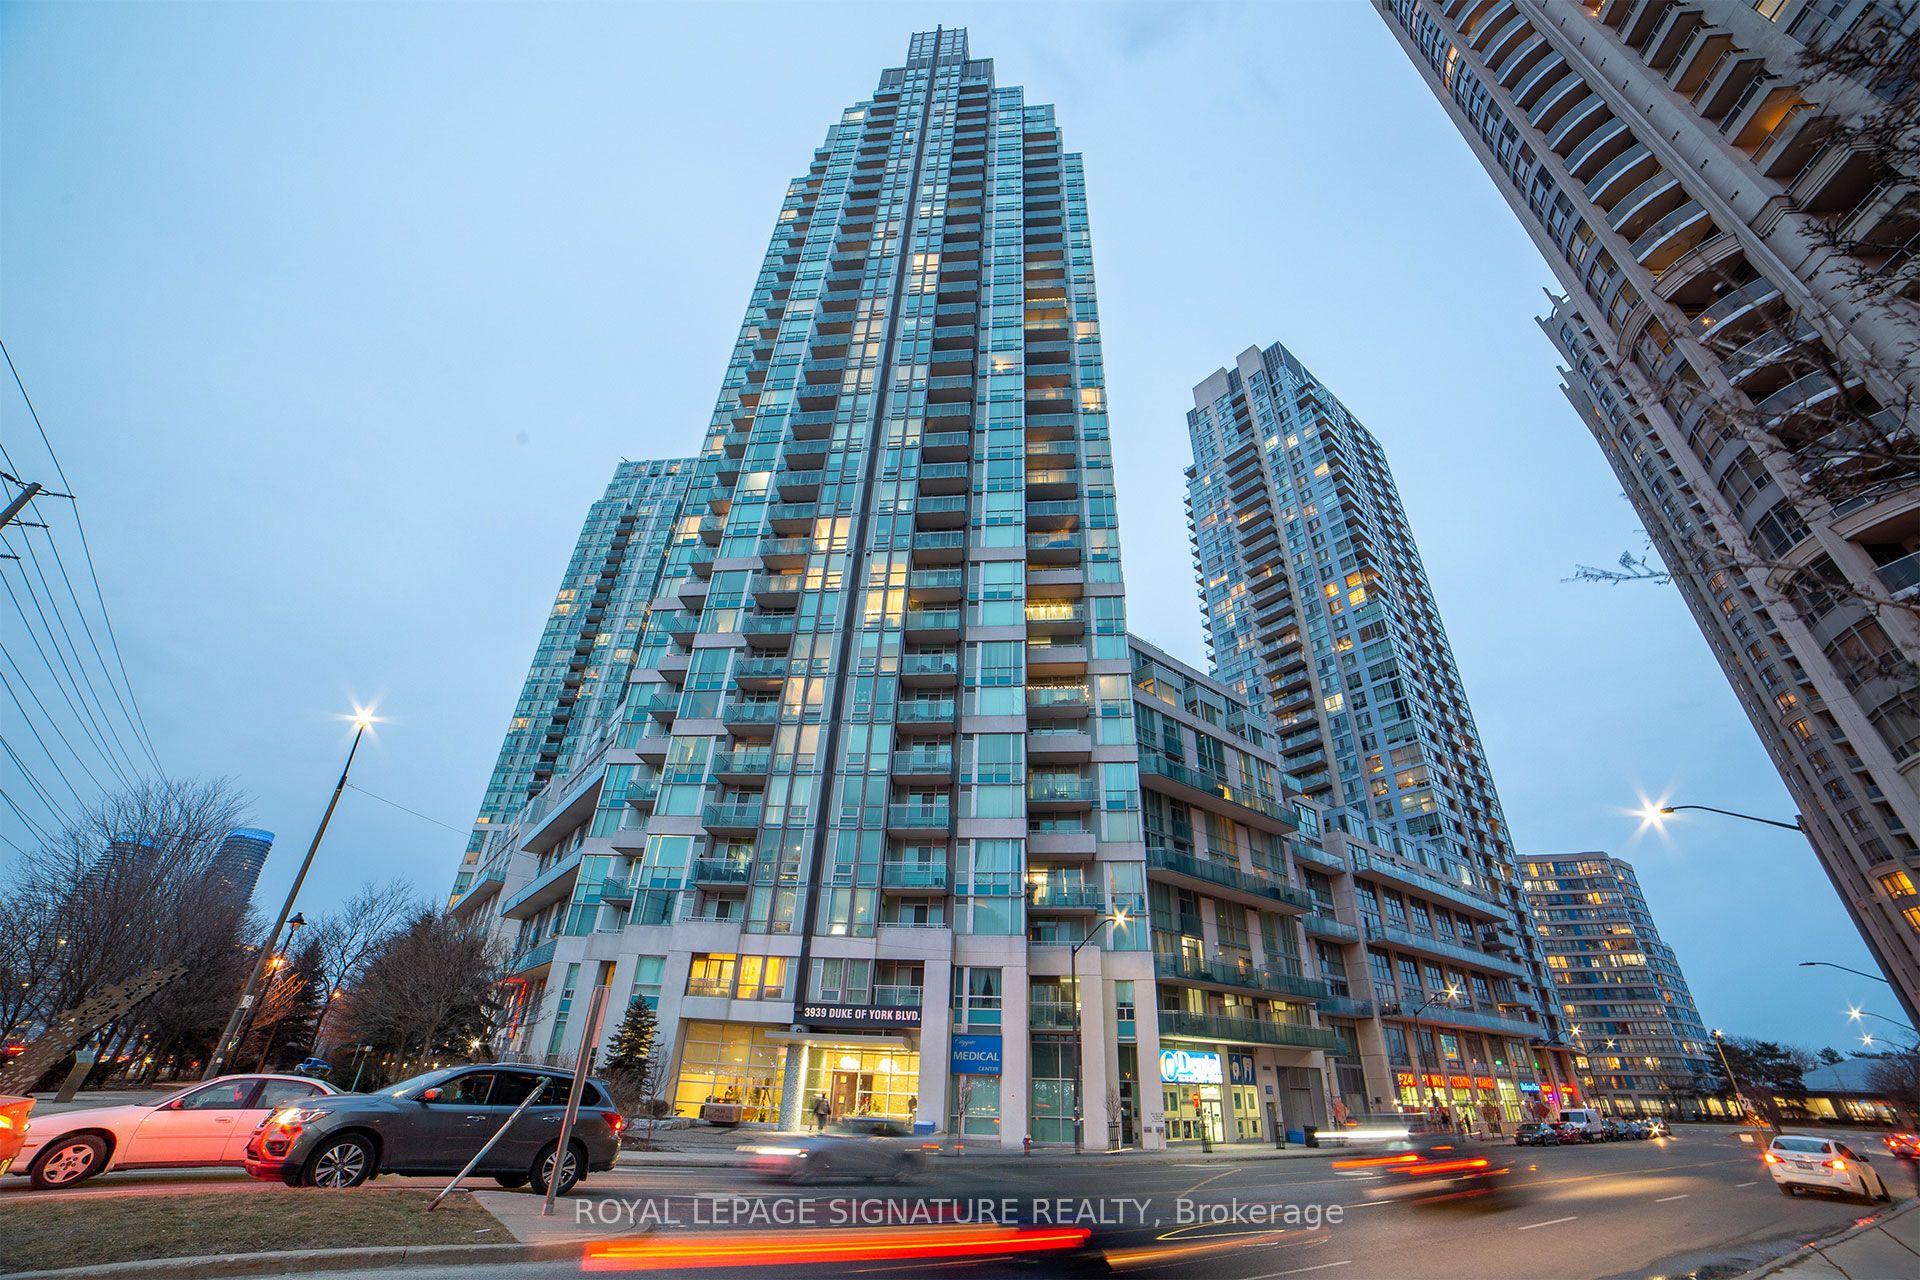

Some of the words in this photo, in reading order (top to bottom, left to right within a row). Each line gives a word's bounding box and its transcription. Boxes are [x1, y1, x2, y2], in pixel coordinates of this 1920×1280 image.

[804, 1007, 827, 1018] 3939
[828, 1008, 853, 1019] DUKE
[854, 1009, 867, 1020] OF
[869, 1009, 894, 1021] YORK
[895, 1010, 921, 1021] BLVD.
[953, 1051, 1000, 1062] MEDICAL
